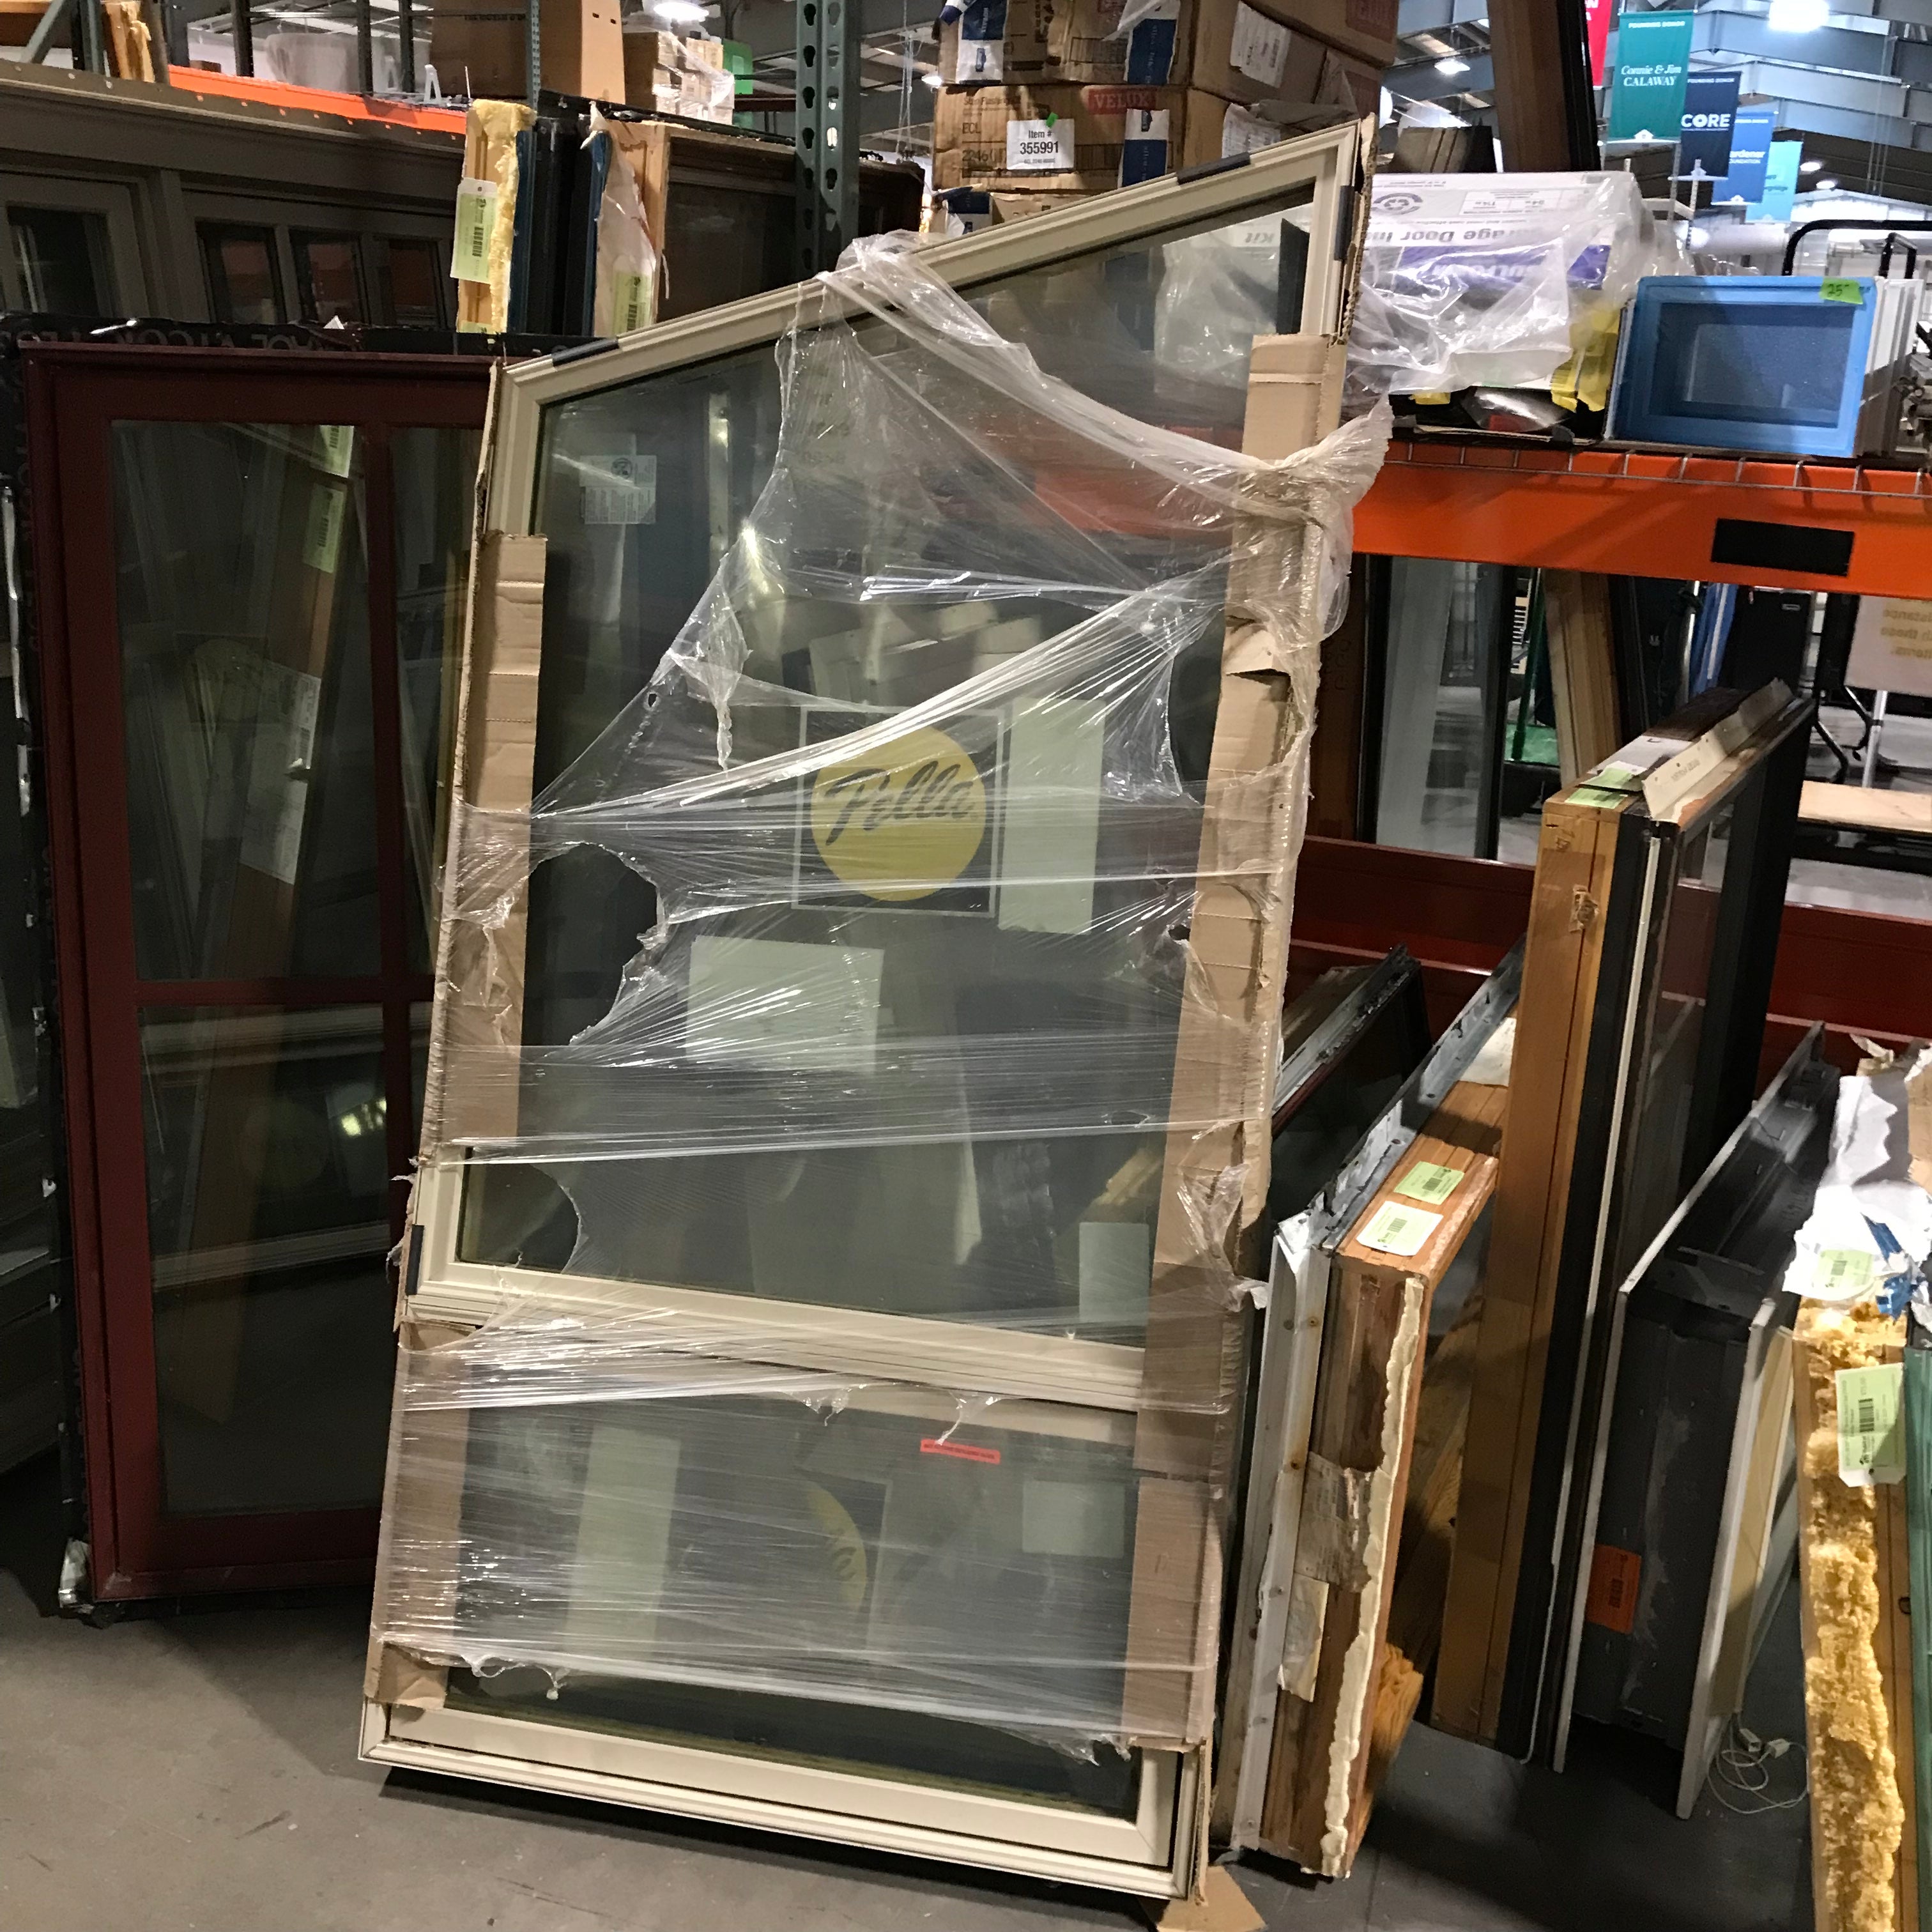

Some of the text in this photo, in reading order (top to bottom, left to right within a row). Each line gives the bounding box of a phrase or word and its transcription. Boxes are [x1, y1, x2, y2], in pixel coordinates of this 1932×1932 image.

[1621, 65, 1682, 75] Connie & Jim
[1623, 77, 1676, 86] CALAWAY
[1094, 91, 1151, 109] VELUX
[1681, 114, 1731, 127] CORE
[1028, 130, 1045, 139] Item
[1020, 141, 1059, 155] 355991
[1400, 231, 1455, 243] Door
[824, 760, 975, 846] Pella
